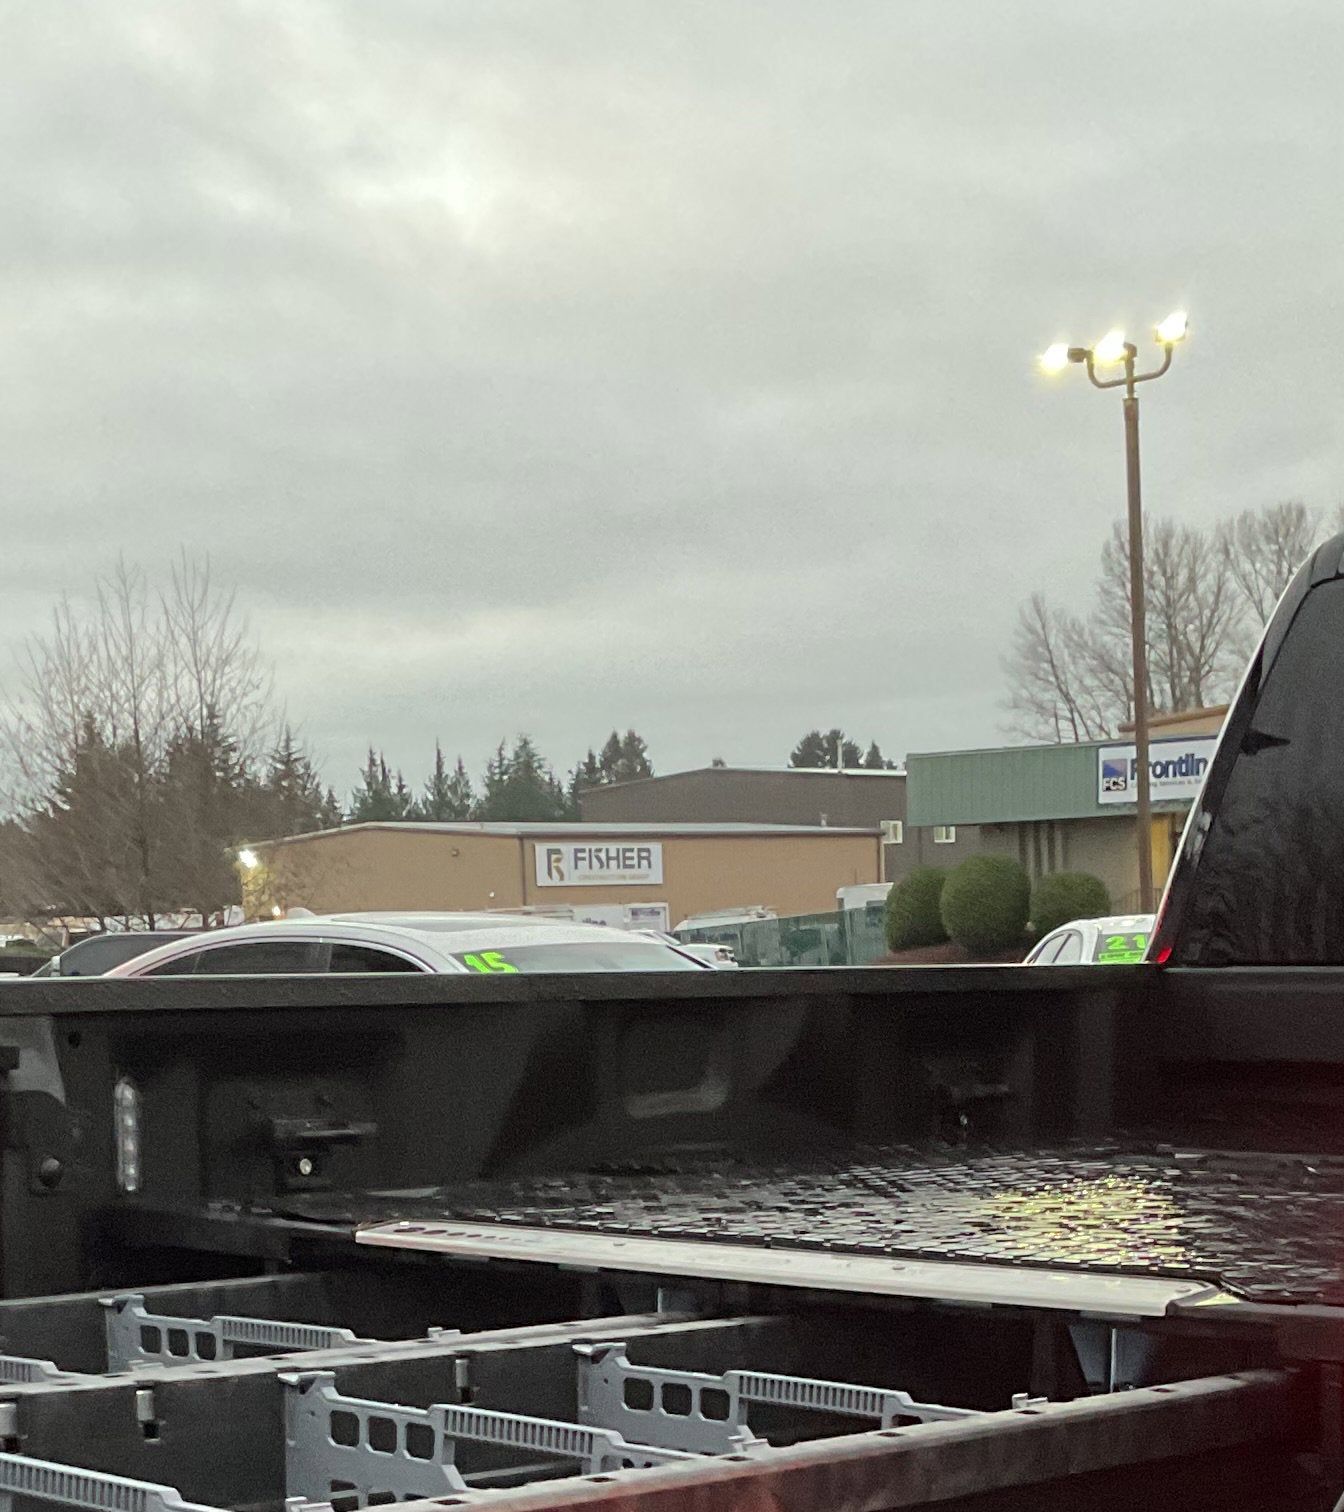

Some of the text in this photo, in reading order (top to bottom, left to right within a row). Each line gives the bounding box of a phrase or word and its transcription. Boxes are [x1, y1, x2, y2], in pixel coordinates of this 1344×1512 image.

[1103, 777, 1126, 792] FCS
[573, 847, 652, 870] FISHER
[464, 952, 519, 973] 15
